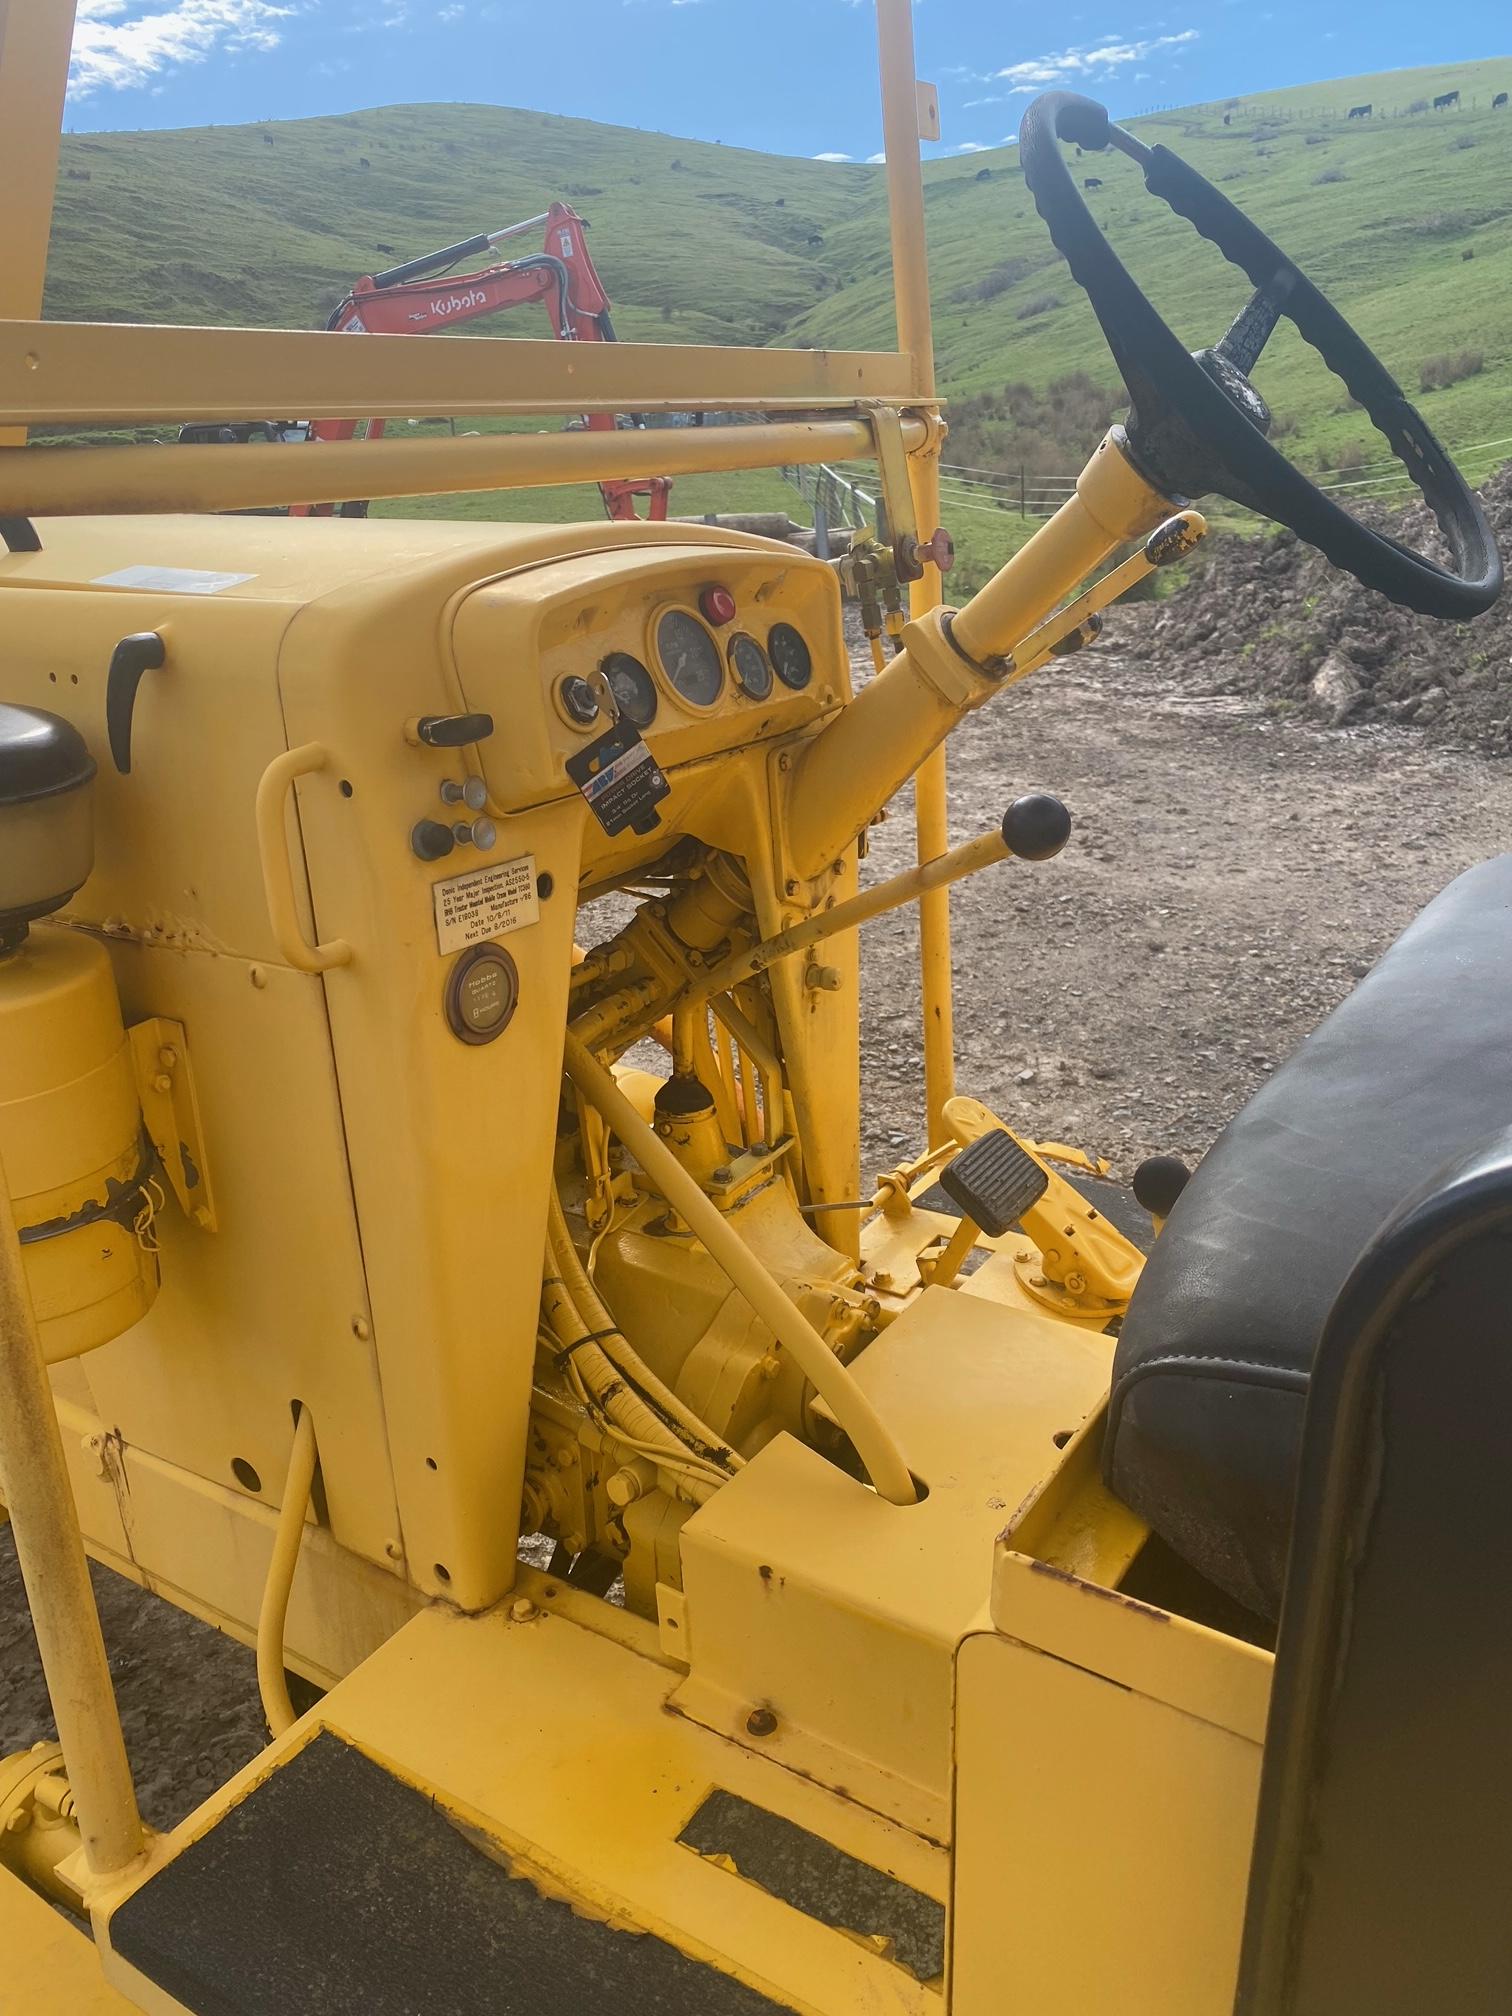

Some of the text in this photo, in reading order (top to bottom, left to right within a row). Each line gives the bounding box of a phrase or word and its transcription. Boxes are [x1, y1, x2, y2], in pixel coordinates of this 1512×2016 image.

[430, 290, 486, 315] Kubota
[600, 767, 652, 809] IMPACT SOCKET
[457, 879, 483, 891] Independent
[484, 871, 510, 883] Engineering
[511, 865, 529, 875] Services
[443, 898, 451, 907] 25
[453, 895, 464, 903] Year
[466, 890, 480, 899] Major
[496, 891, 507, 899] Crane
[445, 917, 457, 927] S/N
[490, 898, 518, 911] Manufacture
[465, 930, 479, 940] Next
[481, 927, 491, 936] Due
[470, 919, 484, 929] Date
